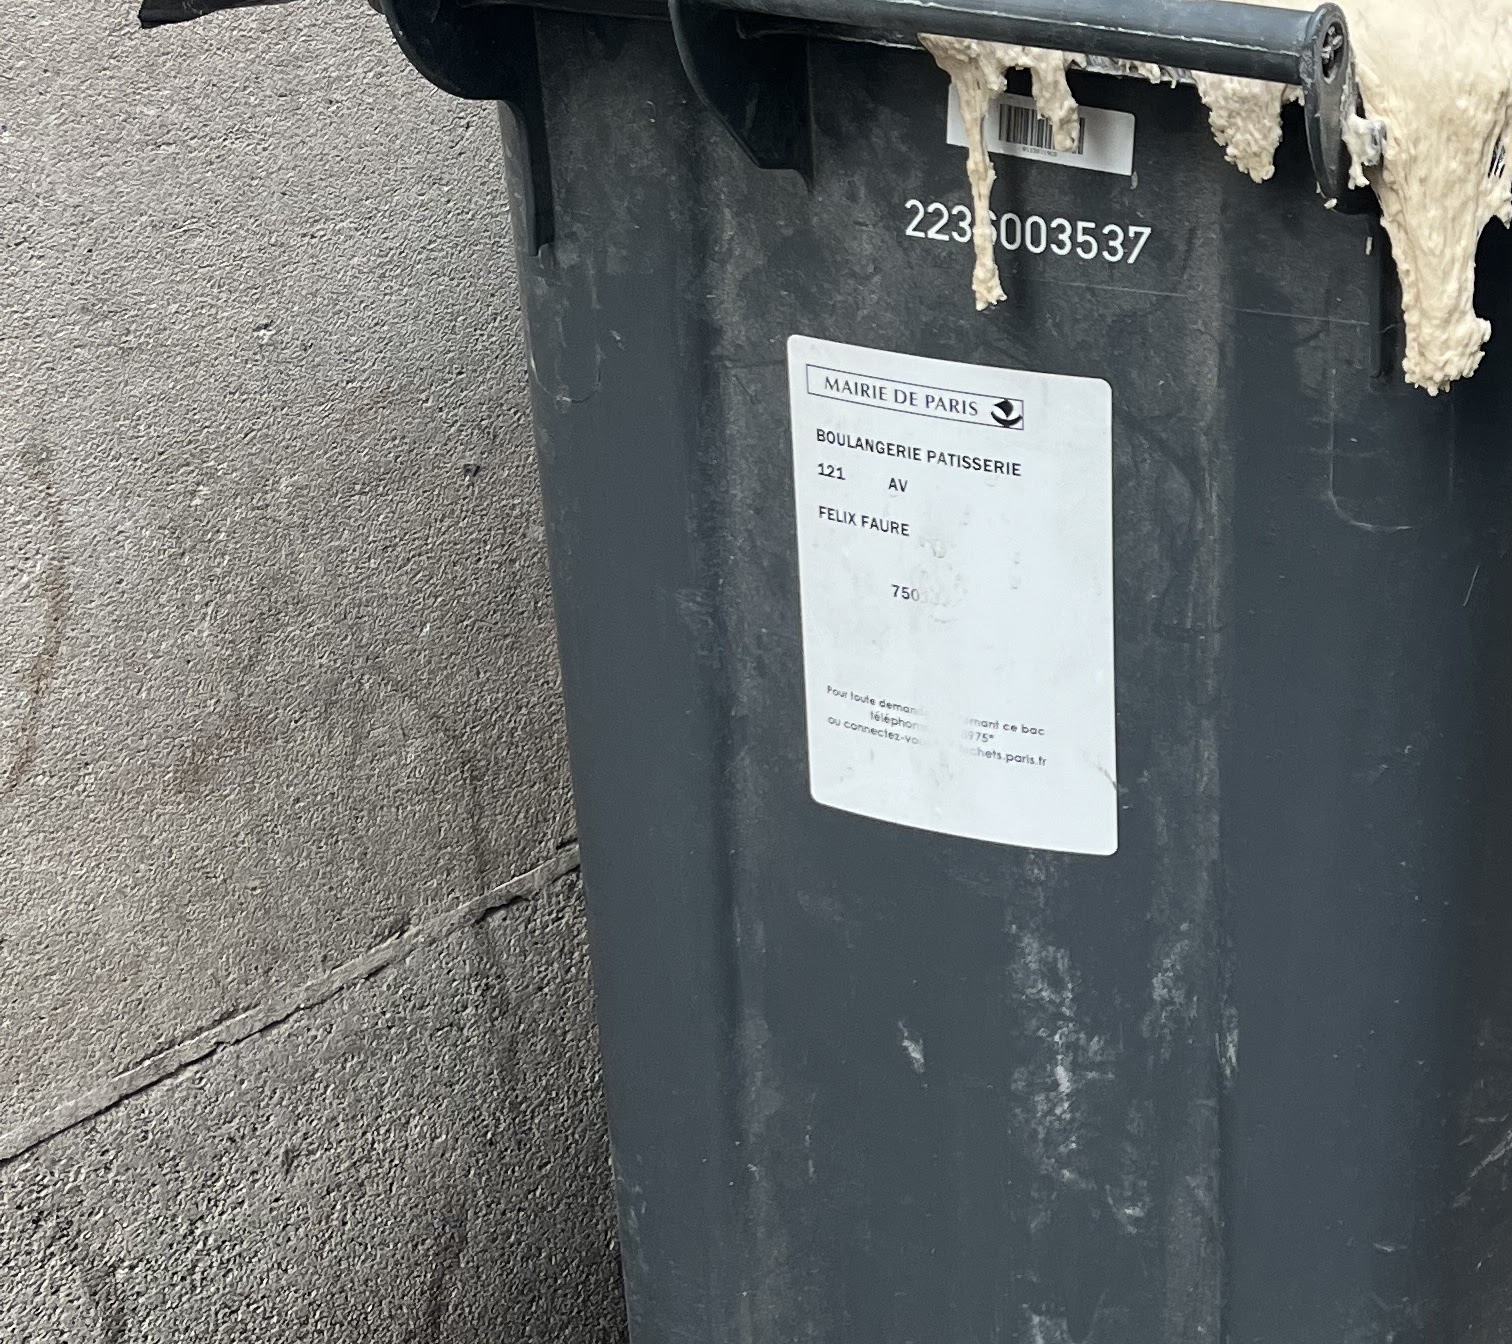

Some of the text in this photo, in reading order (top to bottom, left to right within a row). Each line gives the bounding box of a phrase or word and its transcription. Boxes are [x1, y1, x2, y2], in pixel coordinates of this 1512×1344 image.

[824, 375, 978, 417] MAIRIE DE PARIS
[816, 428, 1022, 477] BOULANGERIE PATISSERIE
[817, 462, 908, 493] 121 AV
[818, 505, 910, 537] FELIX FAURE
[892, 584, 920, 602] 750
[827, 684, 847, 699] Pour
[850, 691, 875, 706] toute
[1002, 723, 1017, 733] ce
[1021, 724, 1045, 737] bac
[828, 716, 841, 726] ou
